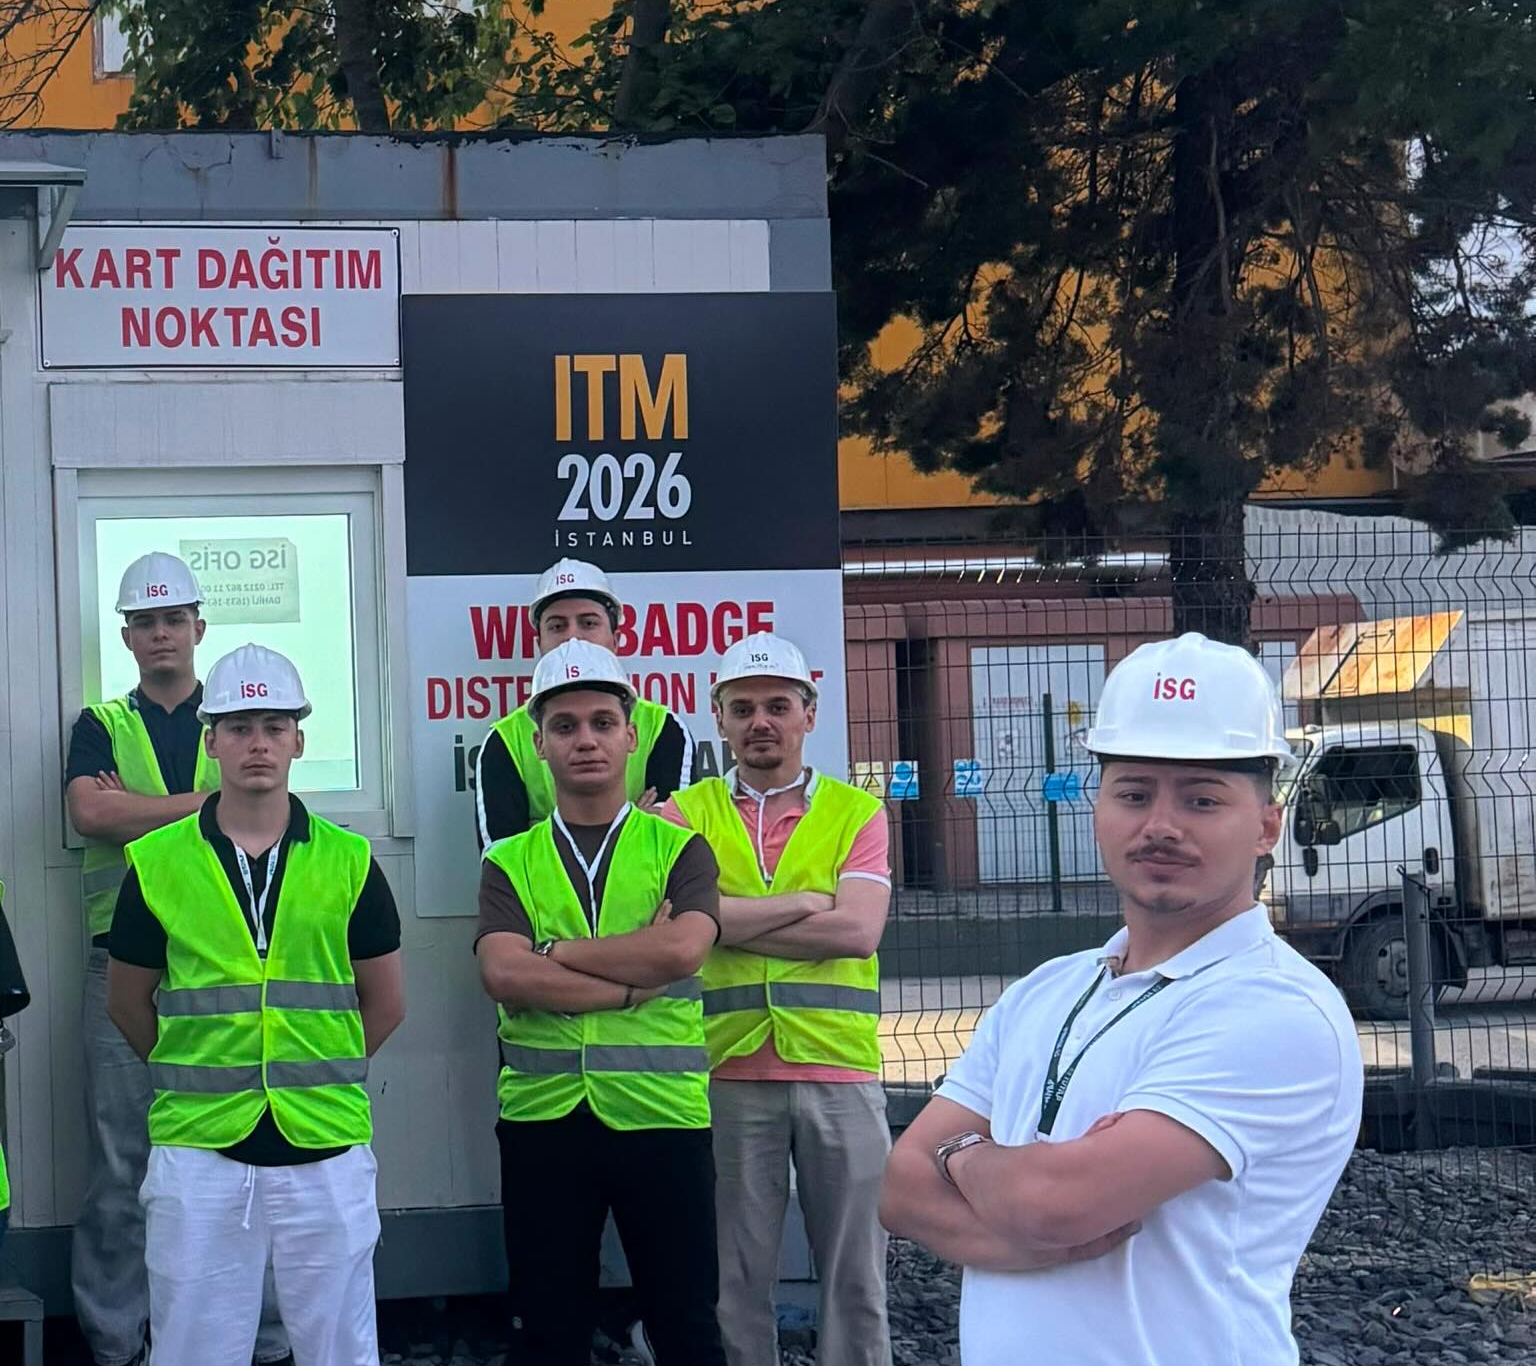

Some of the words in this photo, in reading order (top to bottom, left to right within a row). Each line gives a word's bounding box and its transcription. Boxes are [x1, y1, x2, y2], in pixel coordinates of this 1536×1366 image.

[55, 248, 181, 289] KART
[198, 236, 382, 290] DAĞITIM
[121, 306, 321, 348] NOKTASI
[555, 353, 689, 441] ITM
[557, 452, 692, 522] 2026
[555, 529, 692, 547] İSTANBUL
[1154, 672, 1196, 700] İSG
